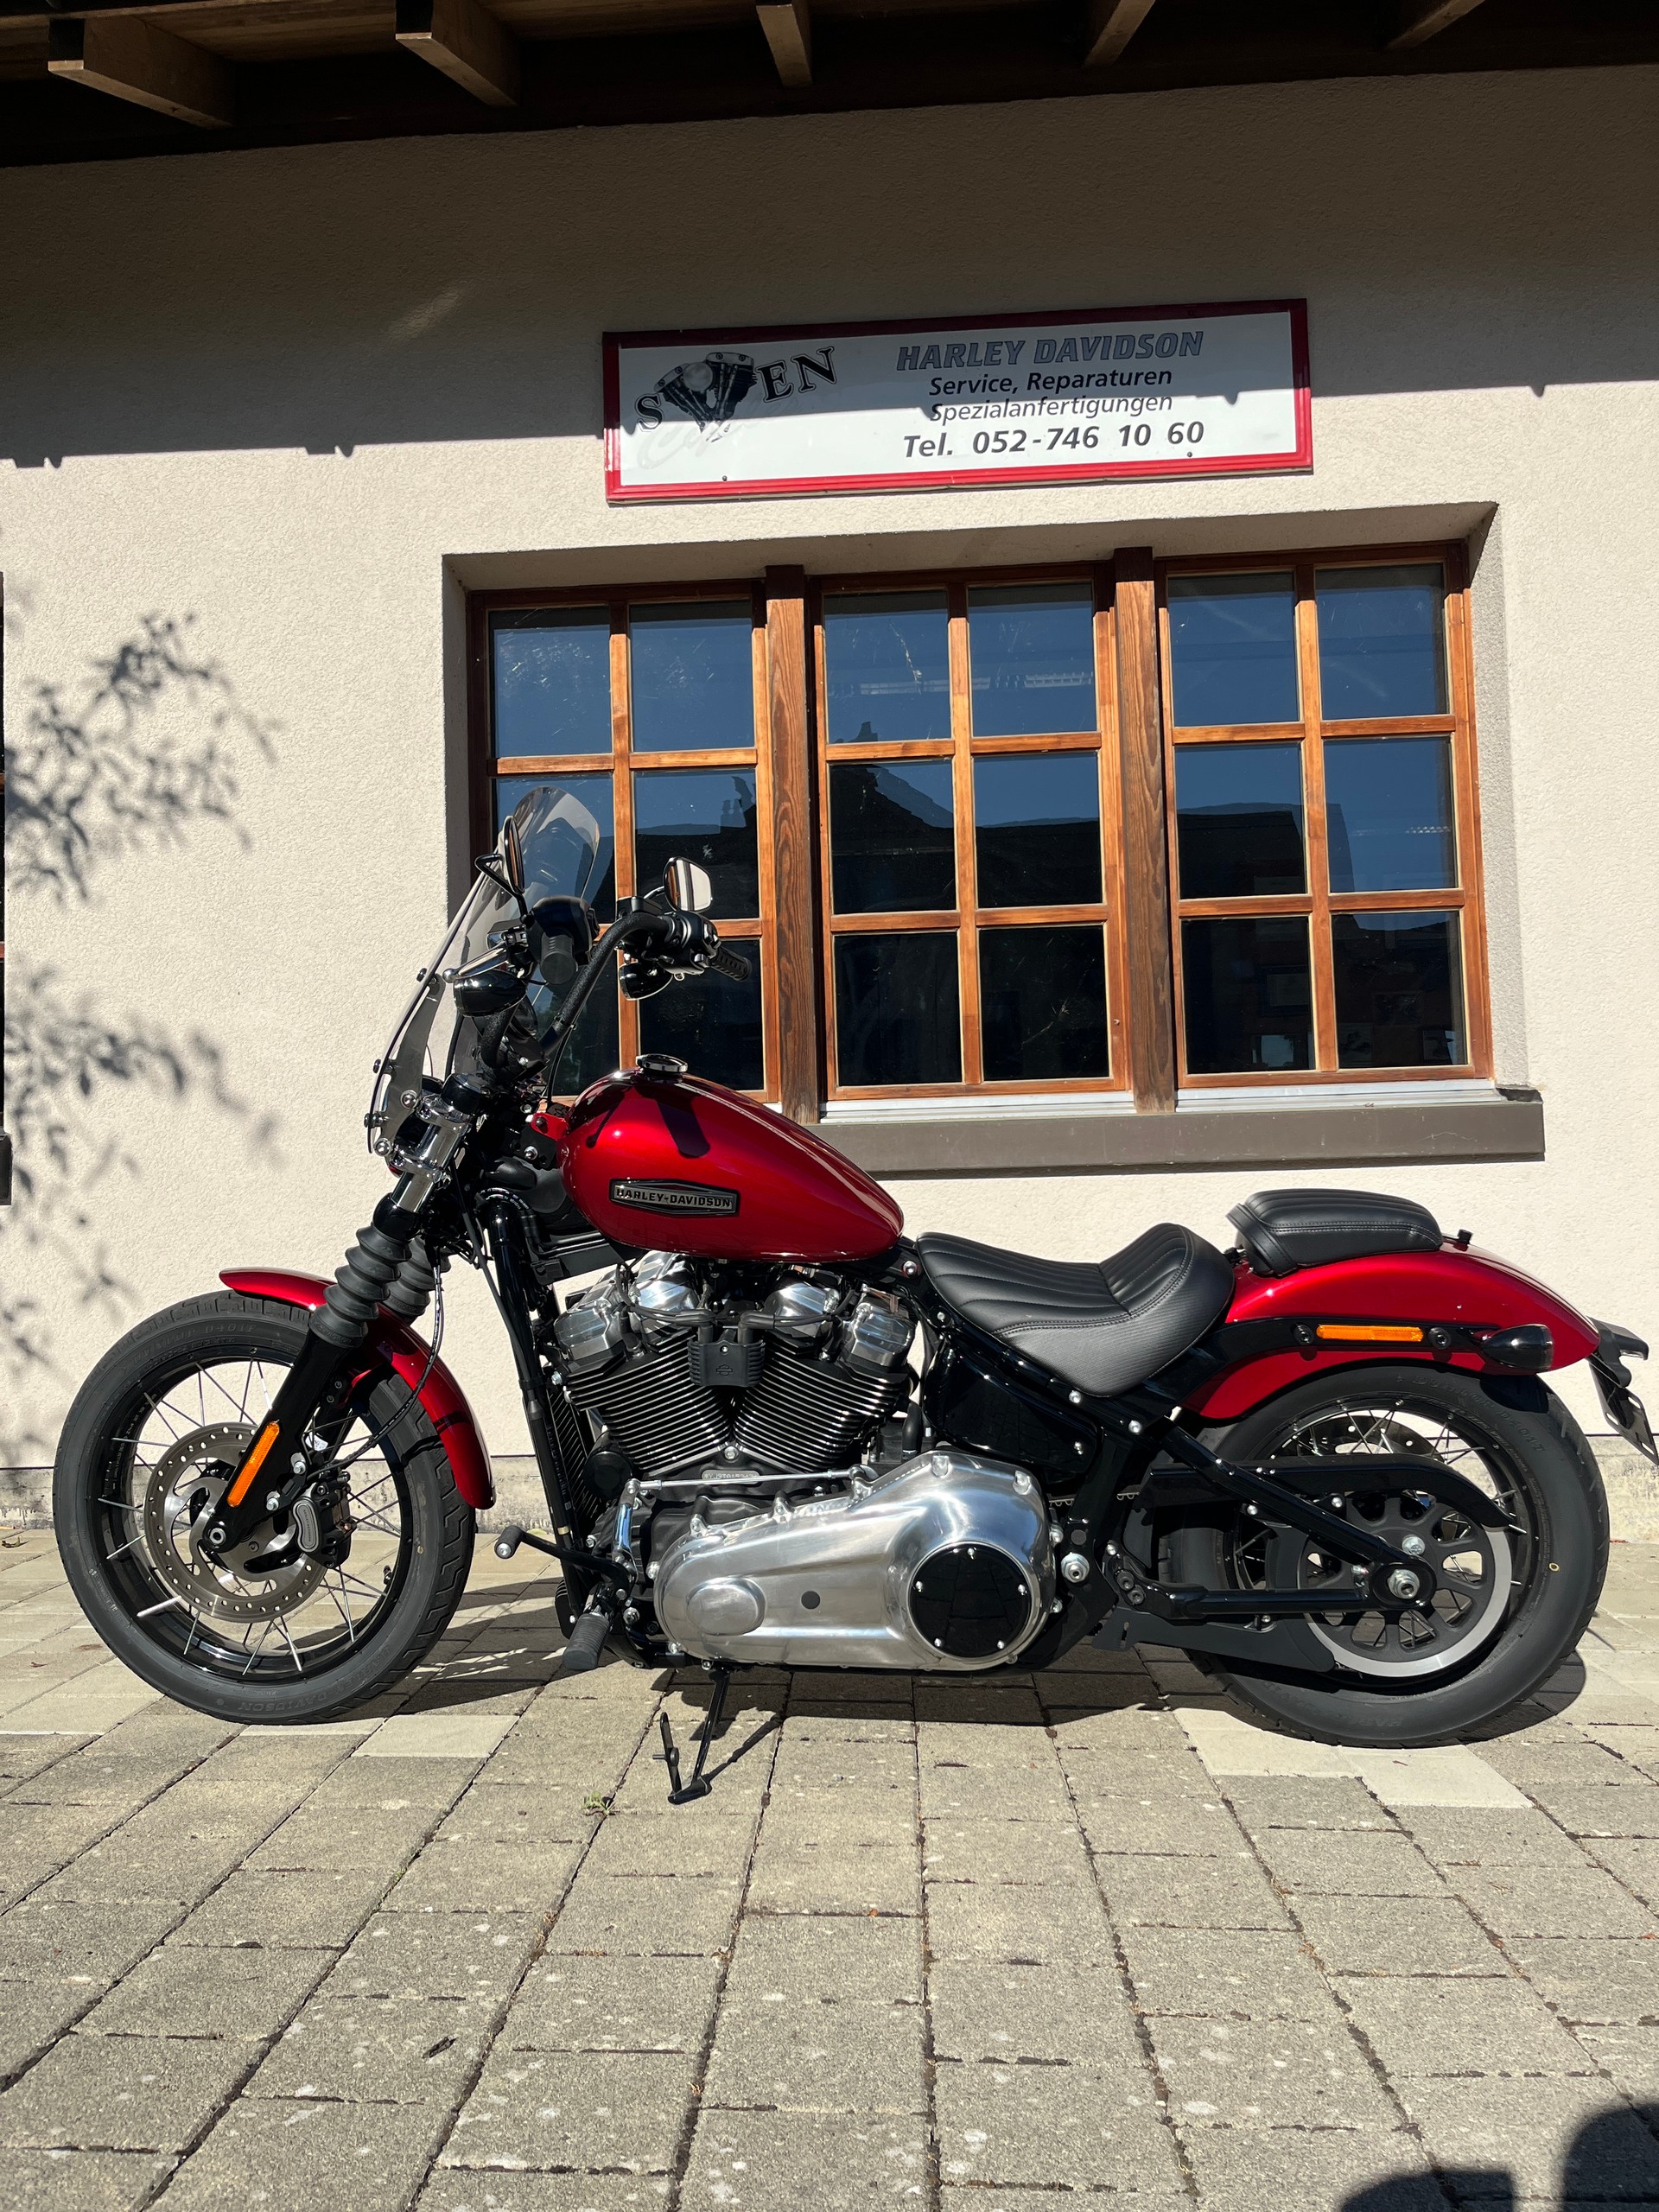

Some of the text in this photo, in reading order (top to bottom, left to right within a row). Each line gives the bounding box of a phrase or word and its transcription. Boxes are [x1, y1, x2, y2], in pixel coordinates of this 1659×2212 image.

[896, 331, 1204, 371] HARLEY DAVIDSON
[929, 367, 1173, 397] Service, Reparaturen
[929, 394, 1173, 426] Spezialanfertigungen
[903, 420, 1205, 459] Tel. 052-746 10 60
[616, 1188, 731, 1208] HARLEY-DAVIDSON
